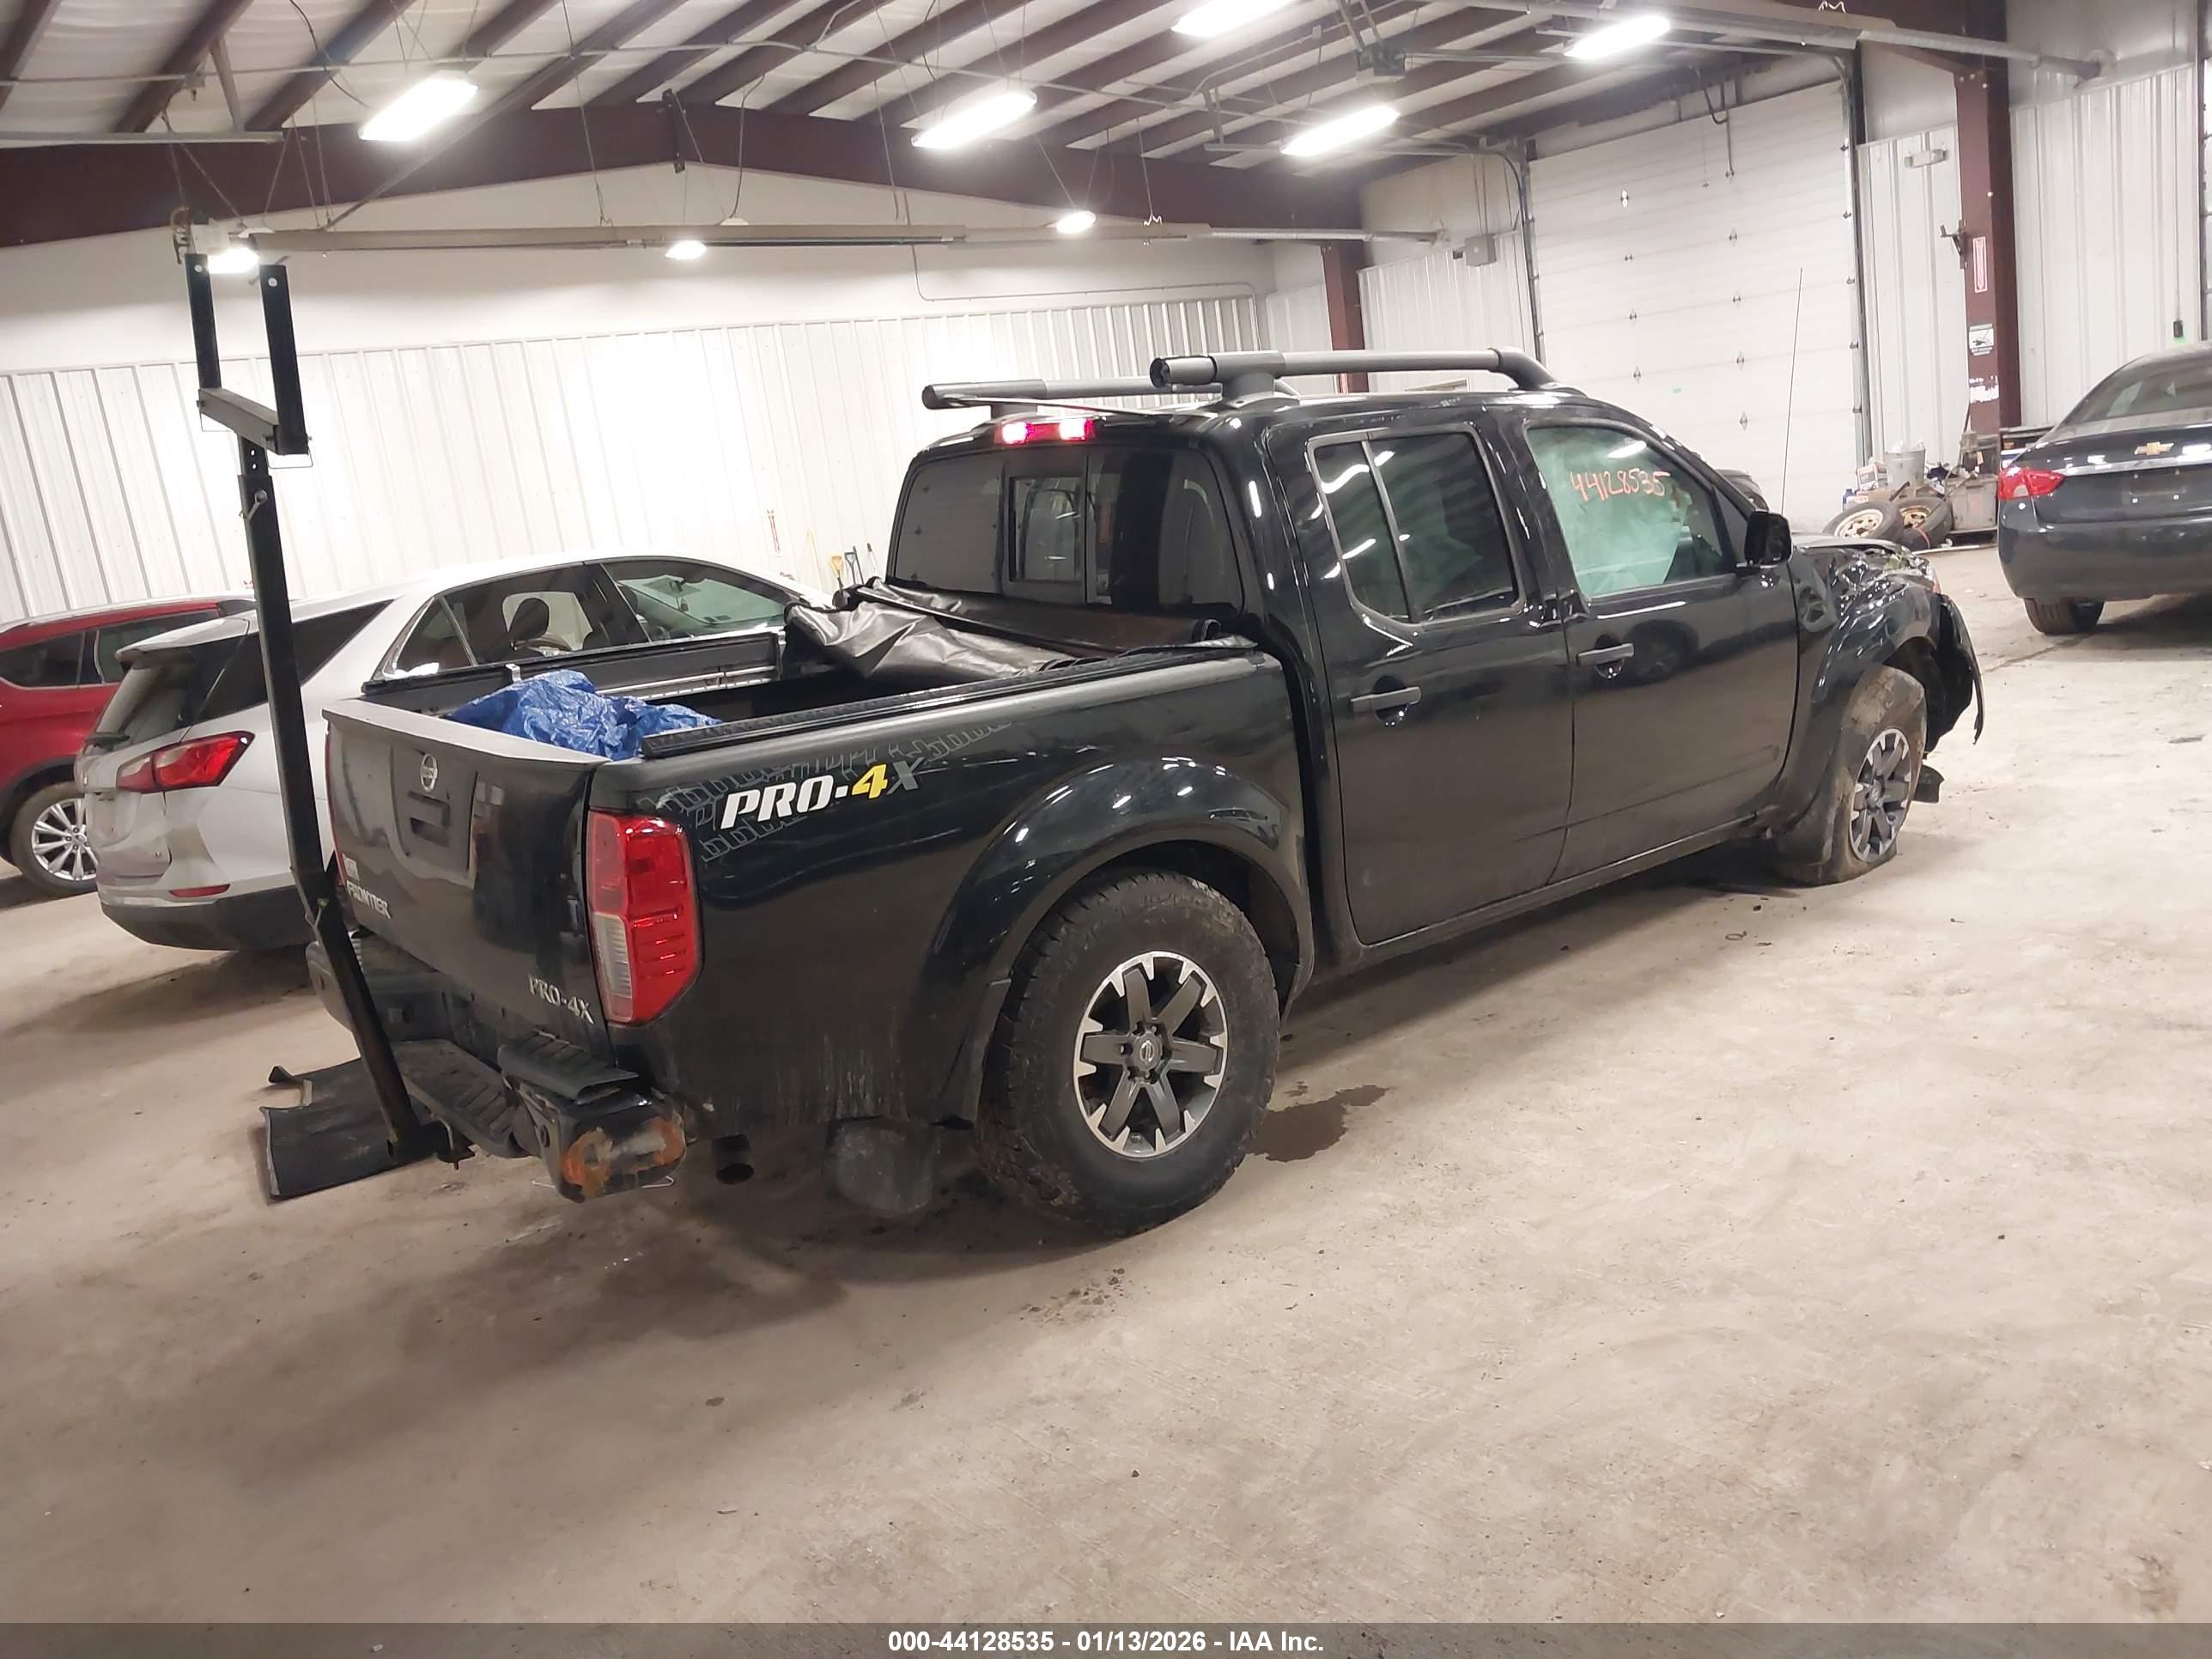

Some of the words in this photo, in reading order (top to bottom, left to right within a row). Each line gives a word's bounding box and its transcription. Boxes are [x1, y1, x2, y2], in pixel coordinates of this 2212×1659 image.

[1570, 467, 1671, 502] 44128535
[720, 757, 925, 830] PRO-4X
[346, 879, 392, 920] FRONTIER
[528, 974, 594, 1024] PRO-4X
